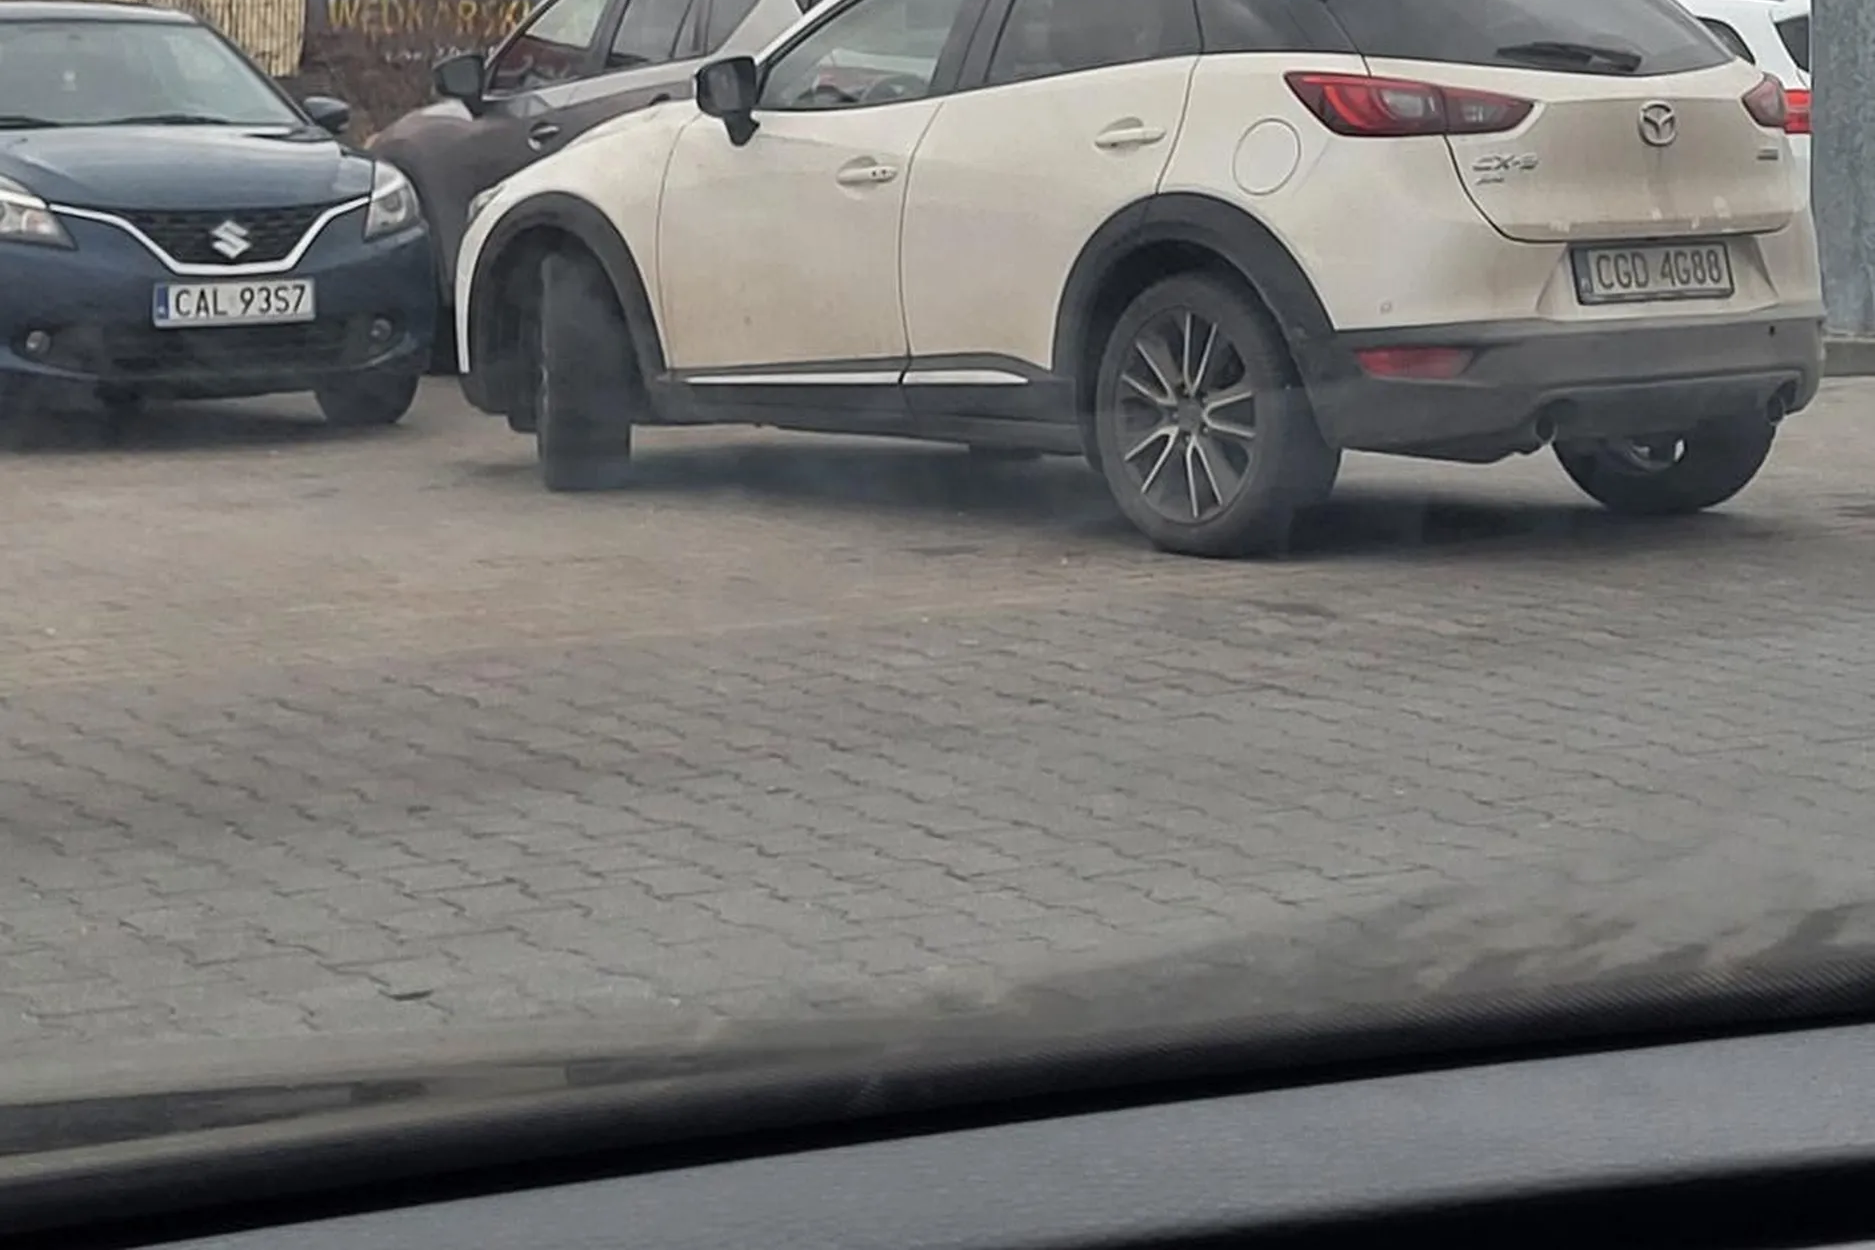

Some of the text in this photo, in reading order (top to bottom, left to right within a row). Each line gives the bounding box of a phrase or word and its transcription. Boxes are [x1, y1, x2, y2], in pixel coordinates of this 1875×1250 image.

[1594, 248, 1724, 290] CGD 4G88
[175, 288, 228, 316] CAL
